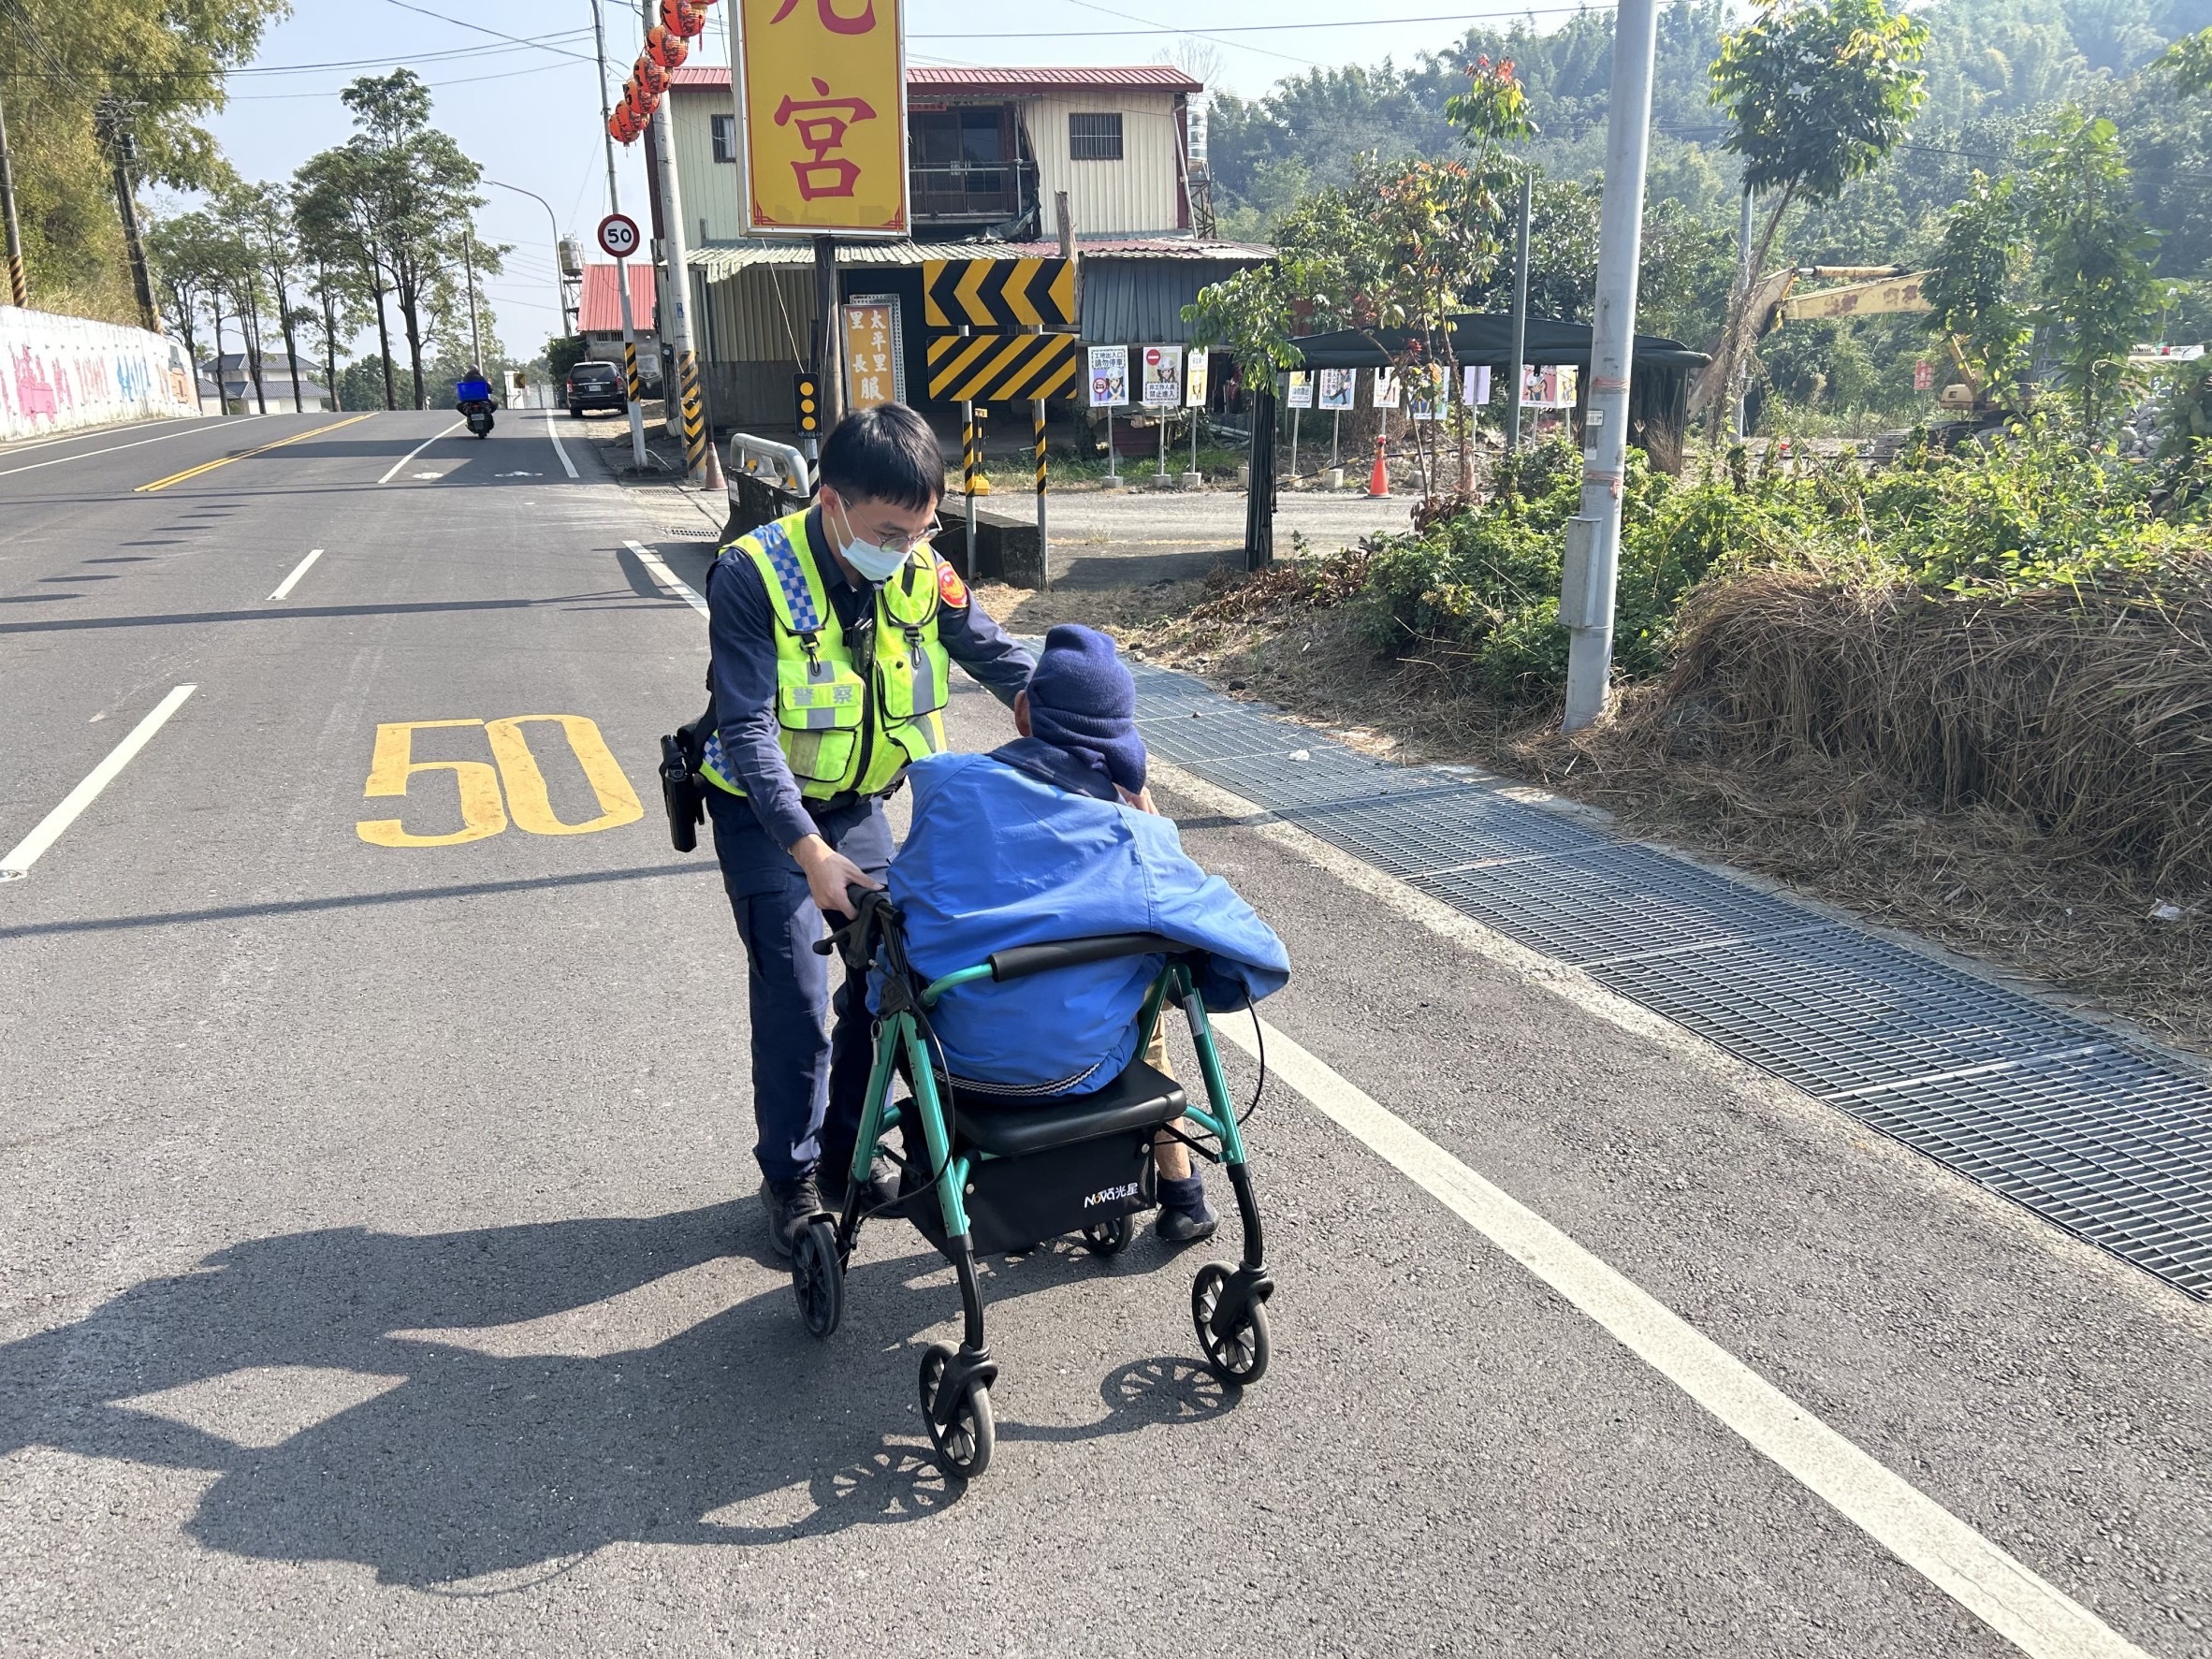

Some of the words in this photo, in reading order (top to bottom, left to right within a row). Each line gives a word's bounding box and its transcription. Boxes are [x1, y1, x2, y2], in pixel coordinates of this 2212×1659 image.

[607, 228, 632, 243] 50
[871, 310, 888, 372] 太平里
[1094, 358, 1123, 367] 請勿停車
[861, 376, 884, 409] 服
[793, 685, 853, 706] 警察
[356, 713, 644, 848] 50
